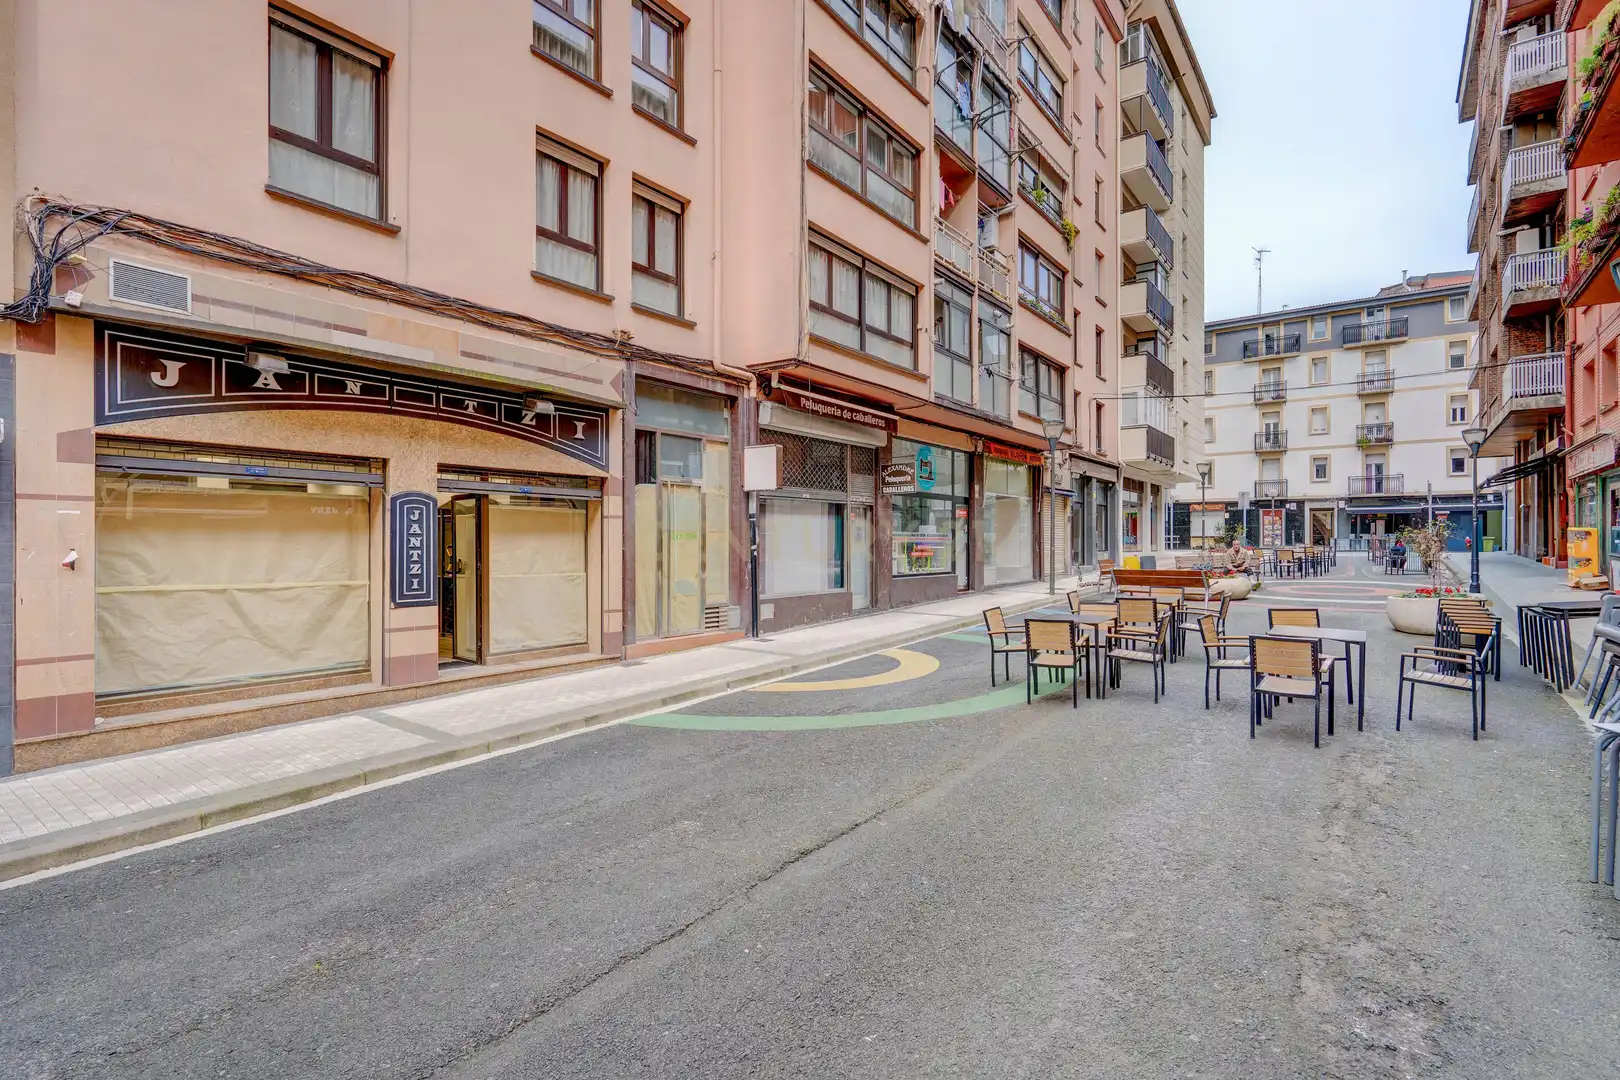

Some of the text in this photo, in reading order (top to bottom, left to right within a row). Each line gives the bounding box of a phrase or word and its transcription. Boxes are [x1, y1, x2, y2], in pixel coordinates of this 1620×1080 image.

[150, 358, 587, 440] JANTZI
[800, 397, 886, 426] Peluqueria de caballeros
[883, 485, 915, 493] CABALLEROS
[408, 510, 422, 589] JANTZI
